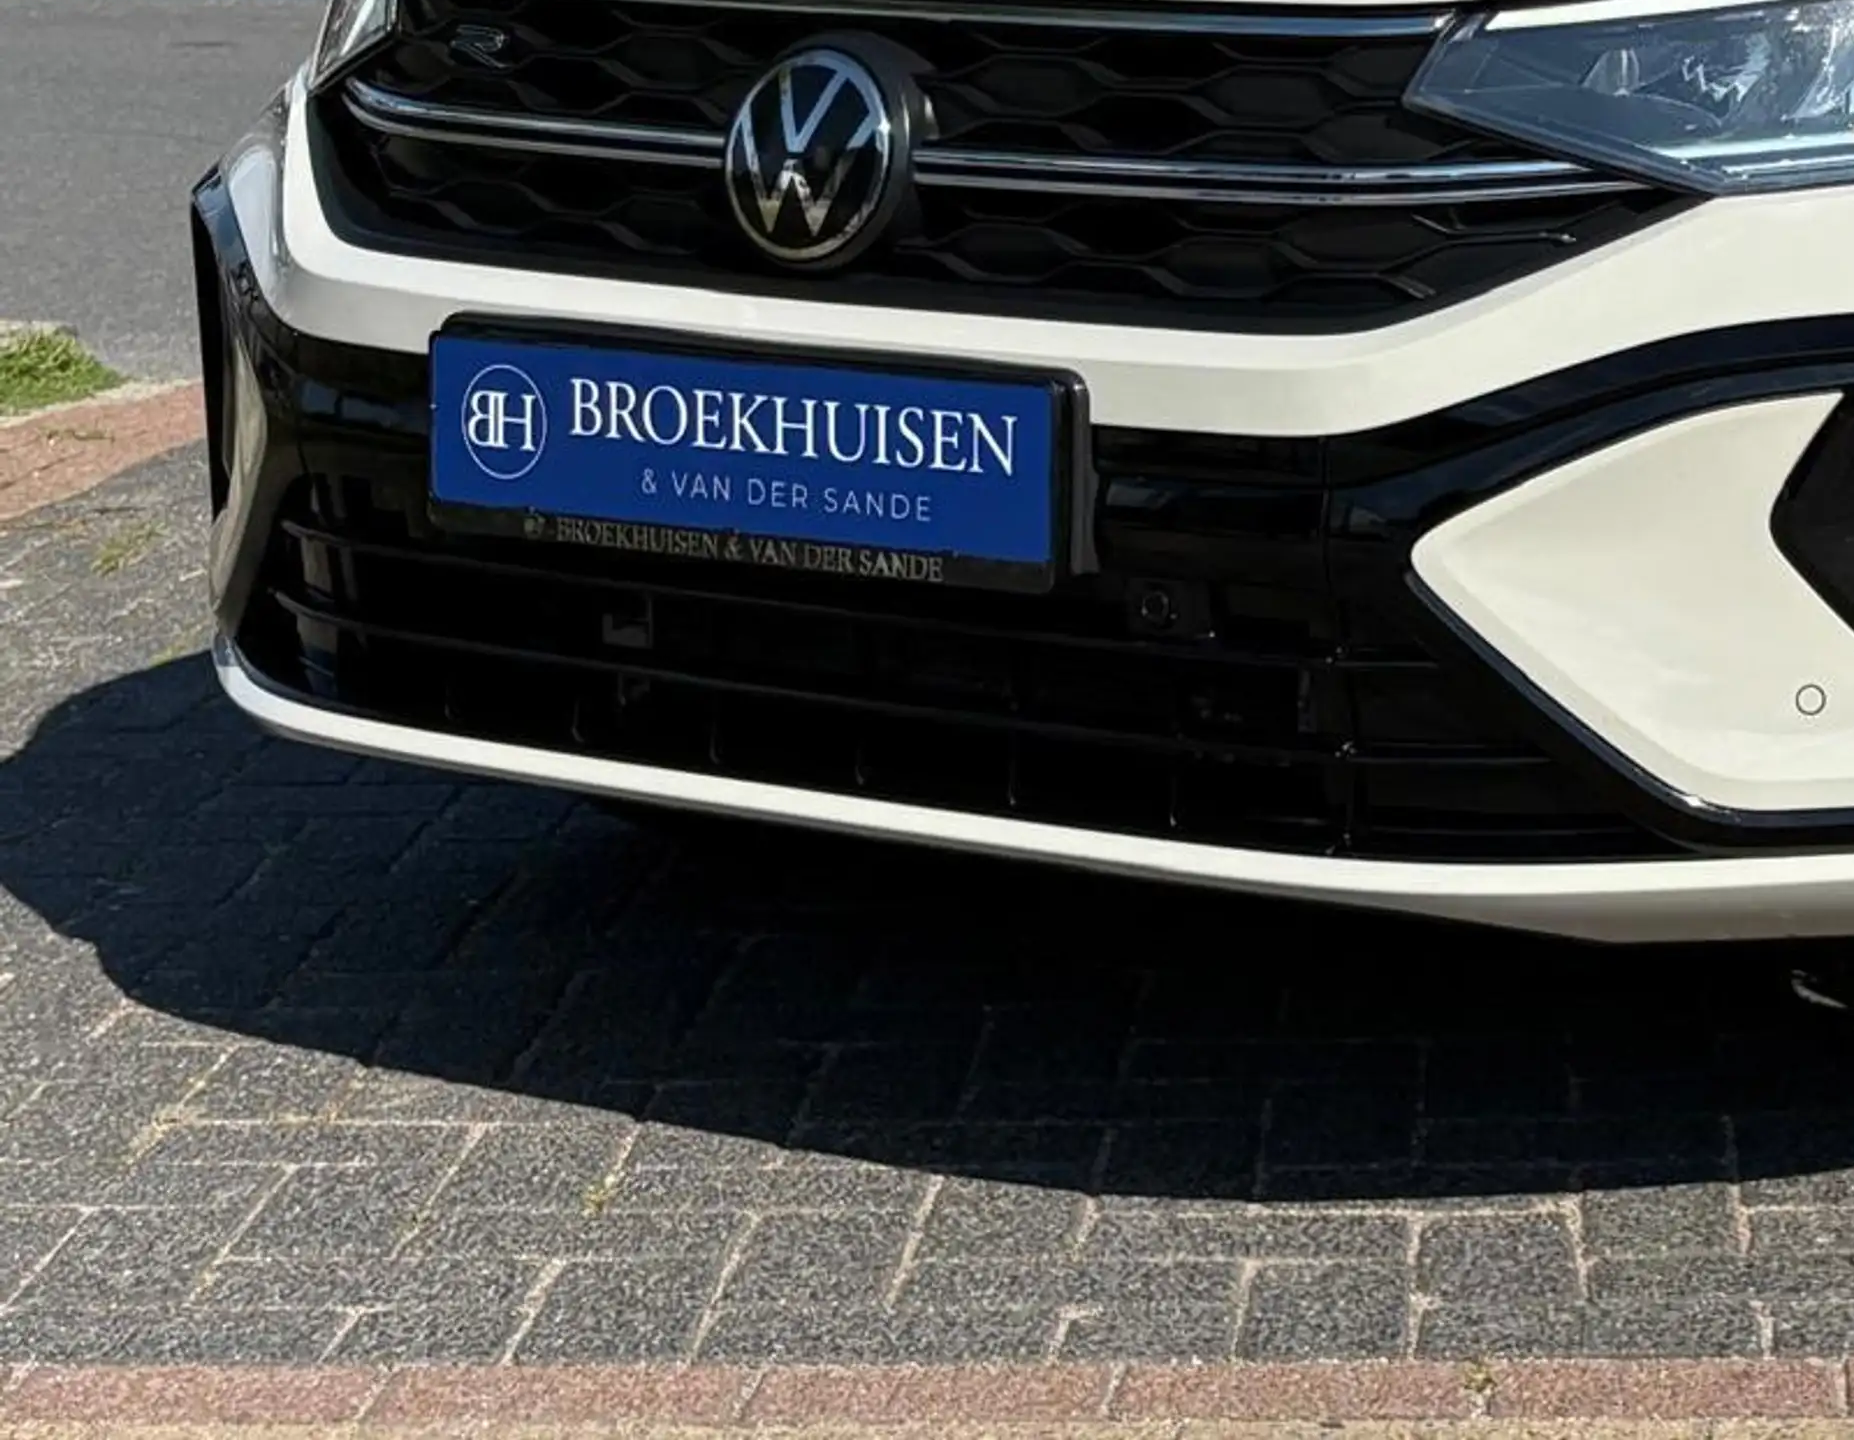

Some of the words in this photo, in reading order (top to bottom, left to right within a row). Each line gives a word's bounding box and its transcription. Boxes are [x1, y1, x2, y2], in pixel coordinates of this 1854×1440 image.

[569, 377, 1018, 477] BROEKHUISEN
[641, 468, 657, 494] &
[671, 470, 732, 502] VAN
[747, 477, 808, 509] DER
[823, 487, 932, 522] SANDE
[556, 516, 719, 560] BROEKHUISEN
[723, 532, 744, 561] &
[749, 537, 798, 567] VAN
[803, 544, 852, 574] DER
[859, 549, 944, 583] SANDE
